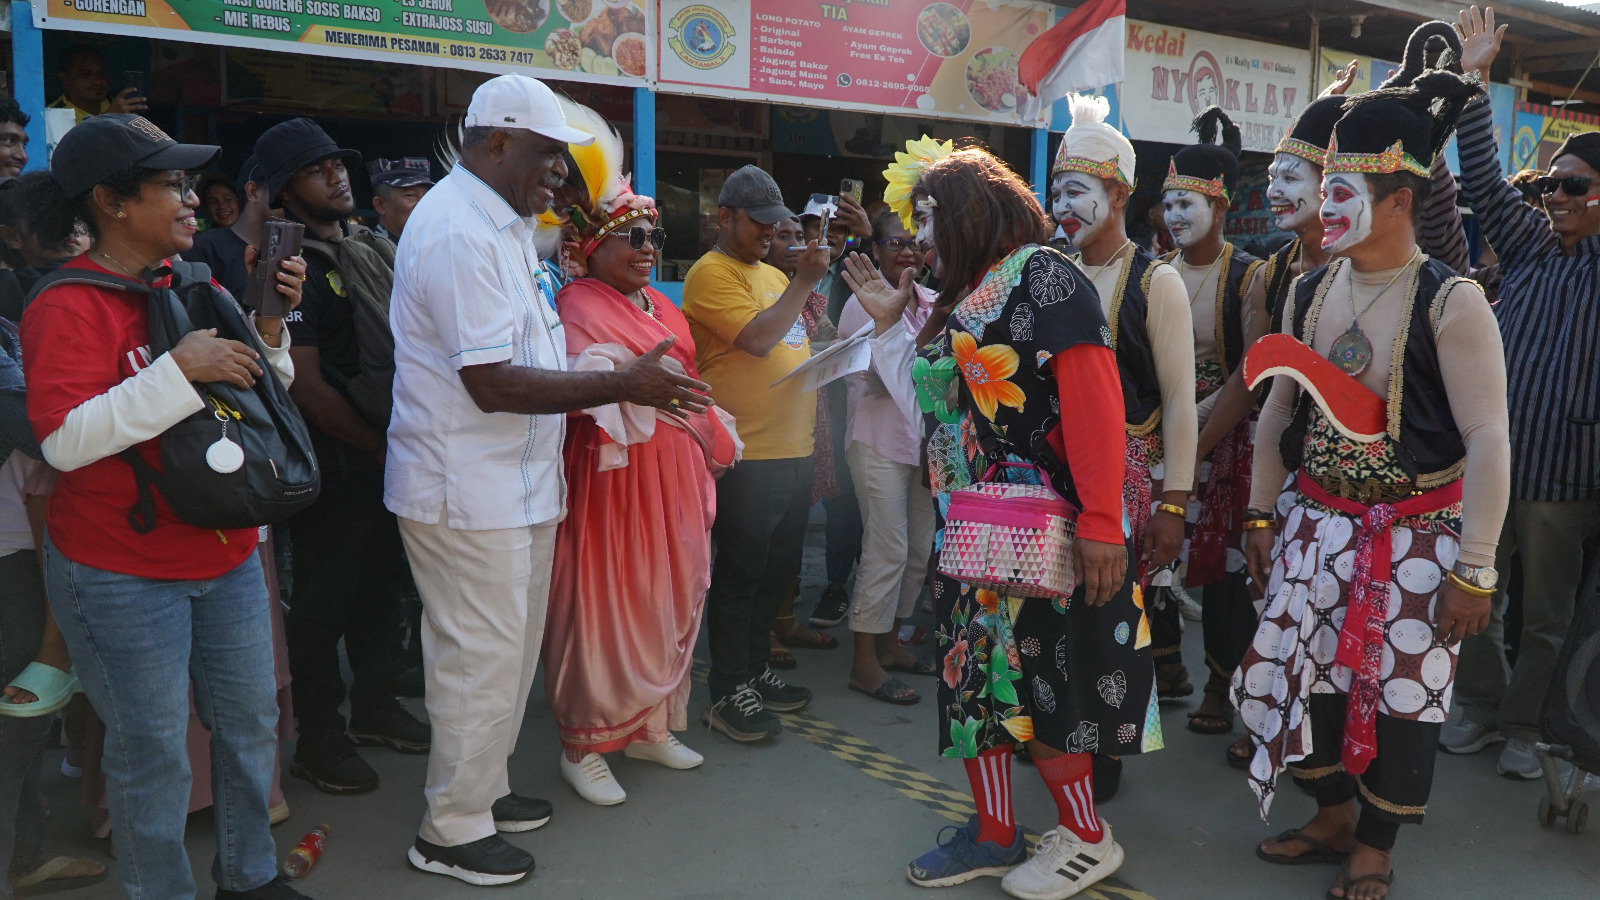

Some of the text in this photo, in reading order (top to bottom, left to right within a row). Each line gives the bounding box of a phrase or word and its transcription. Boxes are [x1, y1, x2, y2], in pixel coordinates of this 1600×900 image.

[75, 0, 146, 16] GORENGAN
[255, 0, 303, 13] GORENG
[306, 1, 340, 17] SOSIS
[343, 5, 381, 22] BAKSO
[418, 0, 453, 11] JERUK
[820, 4, 848, 20] TIA
[224, 11, 291, 32] MIE REBUS
[402, 12, 493, 35] EXTRAJOSS SUSU
[755, 13, 820, 28] LONG POTATO
[760, 25, 799, 37] Original
[843, 26, 902, 39] AYAM GEPREK
[325, 30, 387, 48] MENERIMA
[390, 38, 439, 54] PESANAN
[450, 44, 476, 58] 0813
[479, 47, 506, 61] 2633
[510, 51, 534, 64] 7417
[1127, 24, 1186, 56] Kedai
[760, 45, 795, 56] Balado
[850, 41, 912, 55] Ayam Geprek
[850, 51, 871, 60] Free
[680, 51, 720, 67] LANTAMAL
[760, 56, 828, 70] Jagung Bakar
[760, 66, 828, 80] Jagung Manis
[768, 77, 796, 87] Saos,
[799, 80, 824, 90] Mayo
[1223, 217, 1269, 235] LASIK
